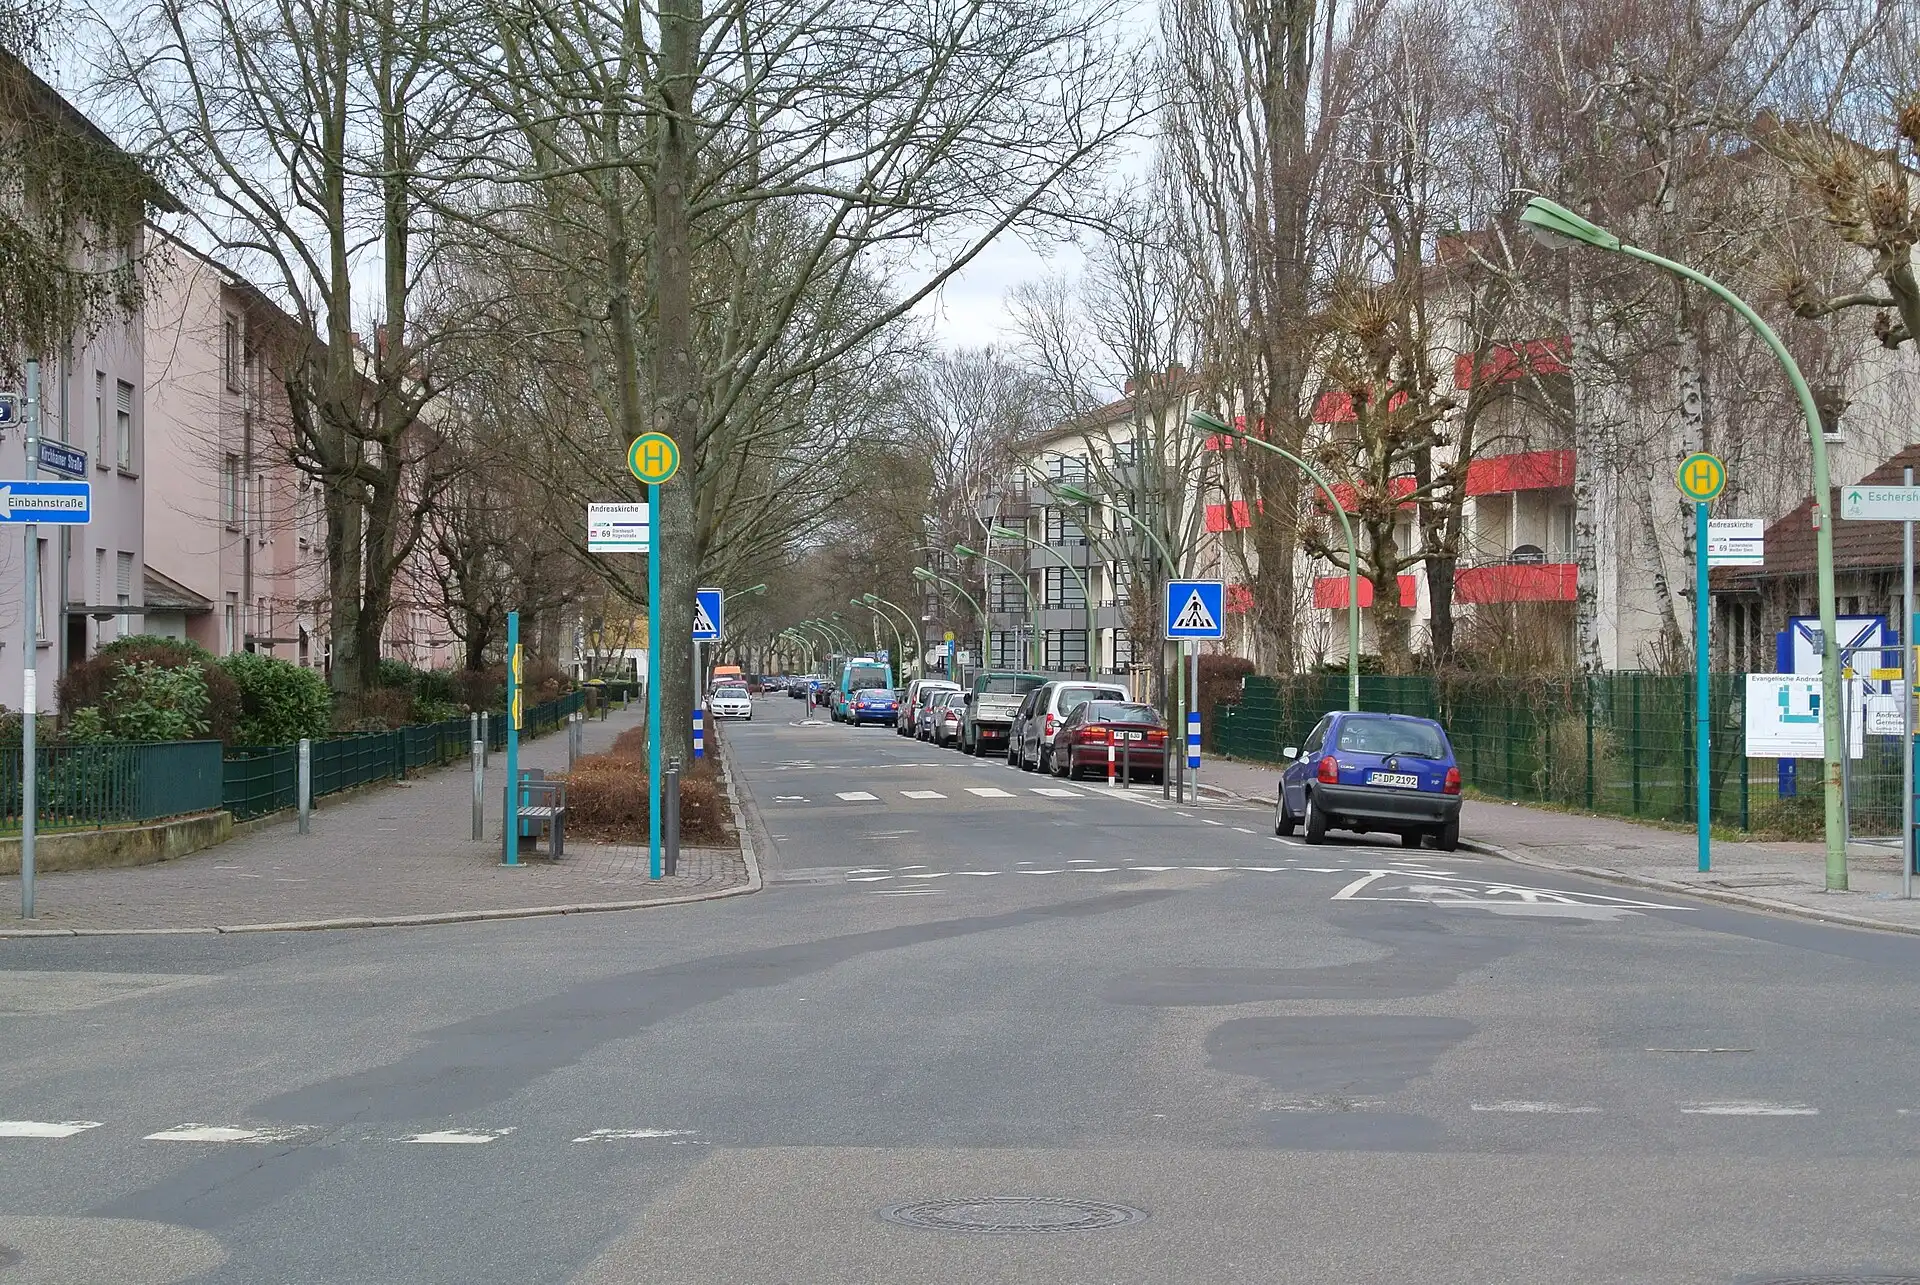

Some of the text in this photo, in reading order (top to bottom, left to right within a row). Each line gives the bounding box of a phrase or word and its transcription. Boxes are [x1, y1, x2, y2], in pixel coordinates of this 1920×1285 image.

[41, 446, 83, 472] Kirchhainer Straße
[644, 445, 663, 472] H
[1693, 465, 1710, 489] H
[1868, 491, 1920, 502] Eschersh
[8, 497, 84, 508] Einbahnstraße
[590, 505, 639, 513] Andreaskirche
[601, 530, 611, 538] 69
[1719, 544, 1728, 552] 69
[1751, 675, 1795, 683] Evangelische
[1372, 773, 1417, 786] F DP 2192
